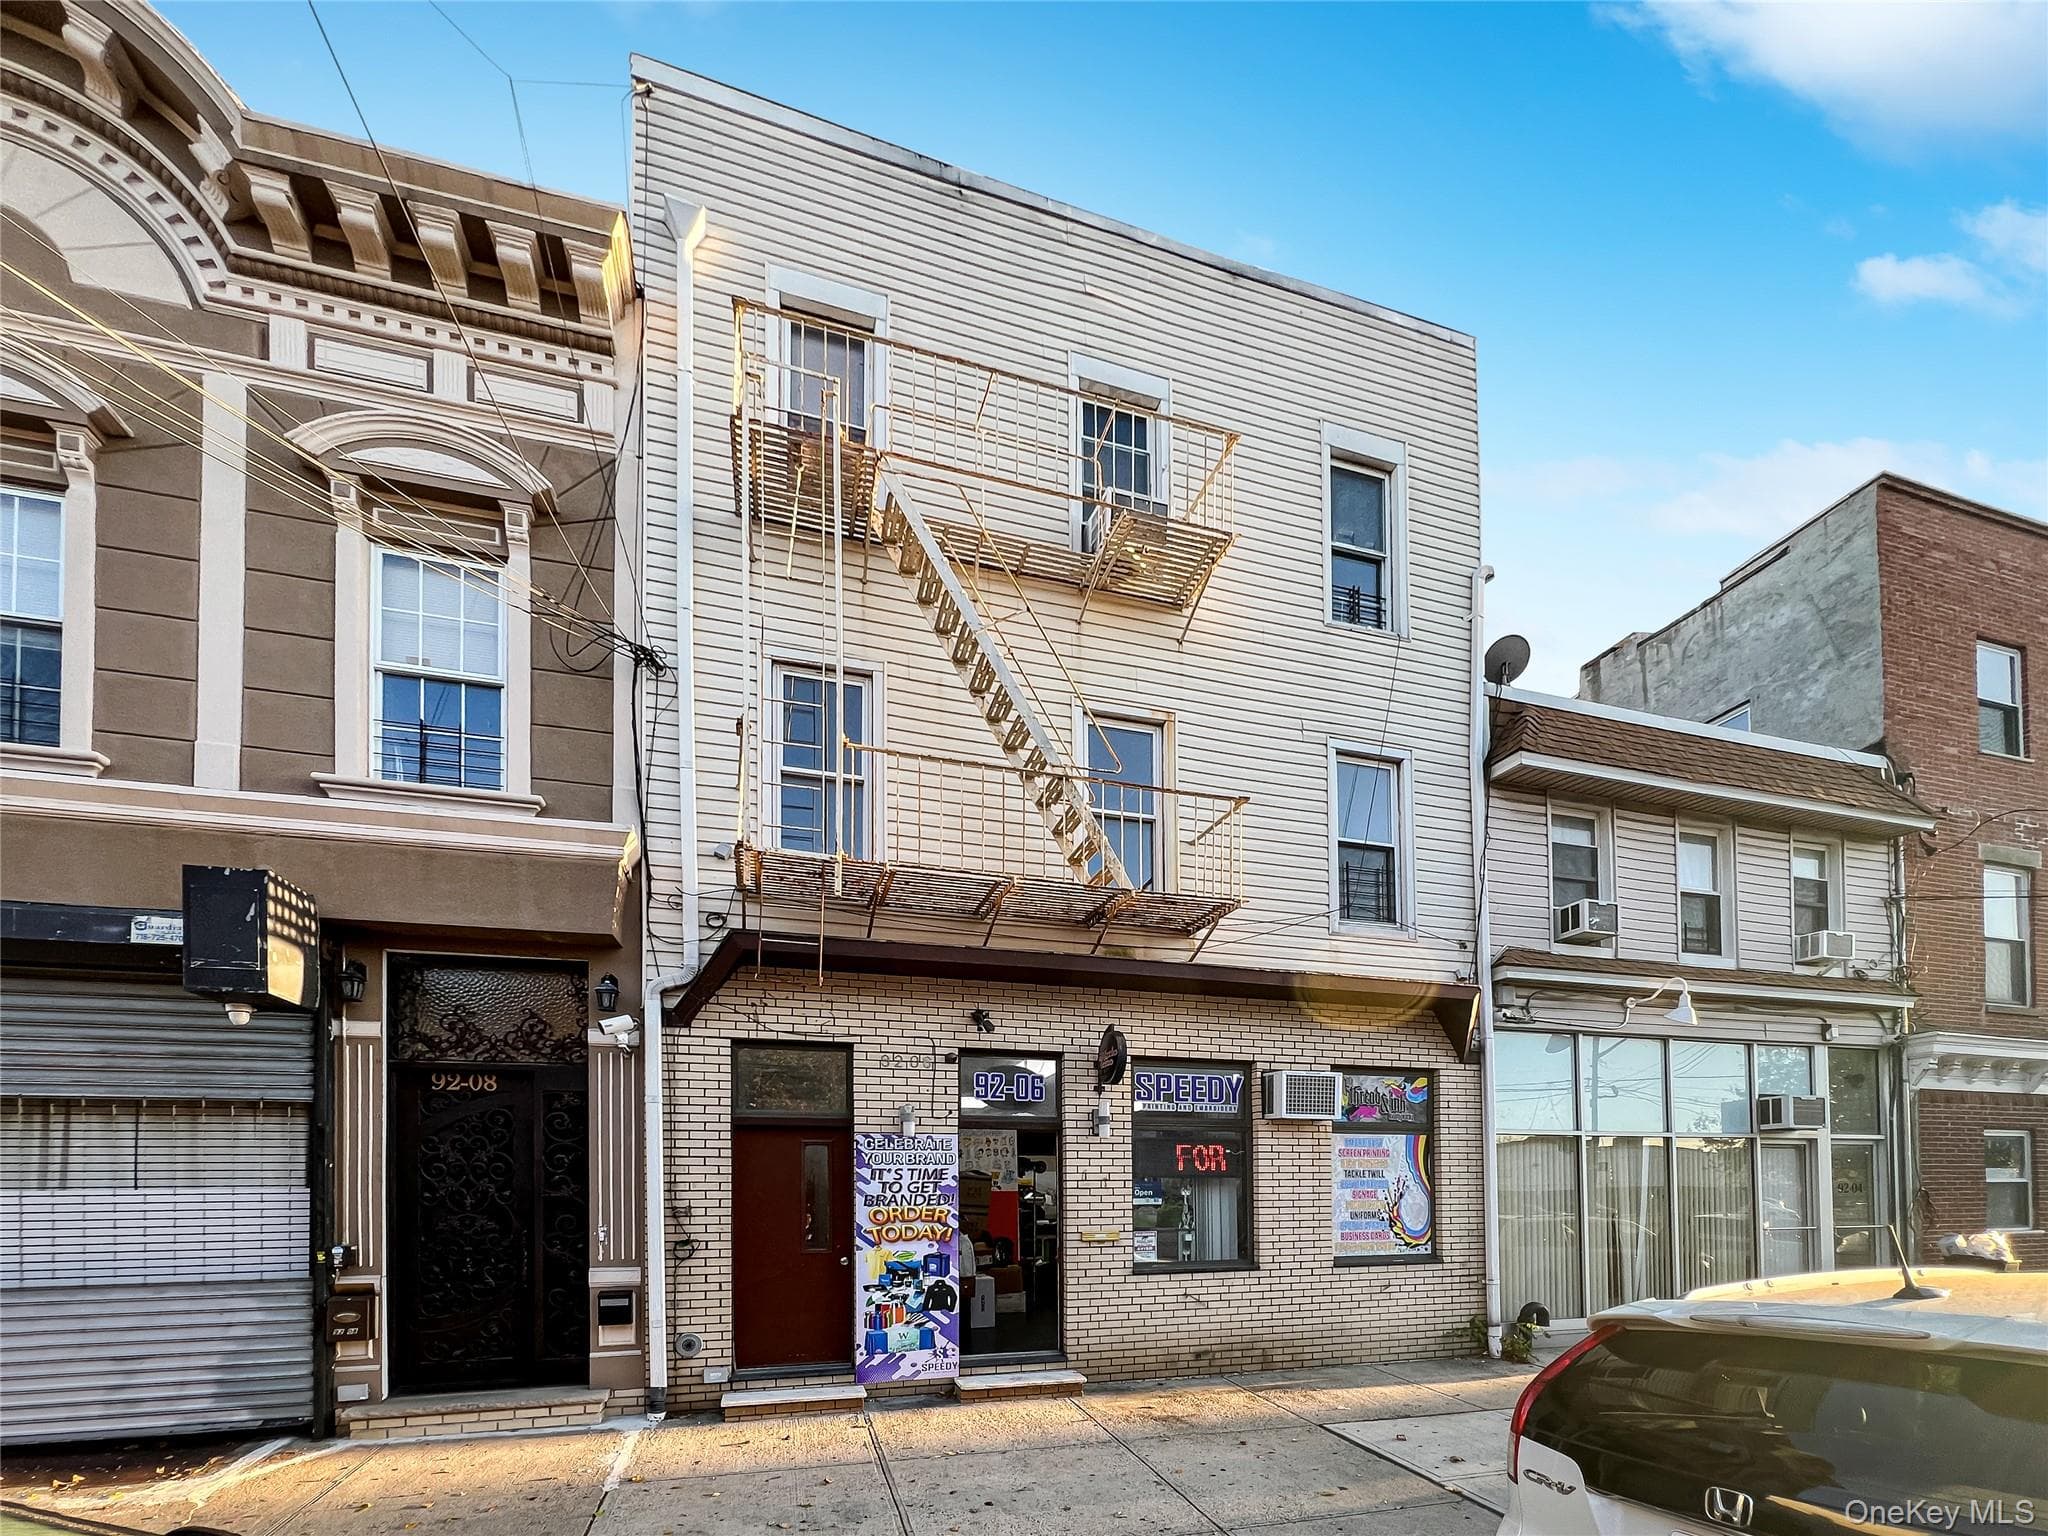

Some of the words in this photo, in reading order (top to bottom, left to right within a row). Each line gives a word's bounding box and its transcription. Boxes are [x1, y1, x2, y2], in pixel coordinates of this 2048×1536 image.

[431, 1072, 497, 1092] 92-08
[974, 1072, 1046, 1102] 92-06
[1135, 1072, 1244, 1104] SPEEDY
[1178, 1103, 1193, 1112] AND
[863, 1137, 953, 1151] CELEBRATE
[862, 1152, 904, 1165] YOUR
[905, 1152, 957, 1166] BRAND
[1176, 1144, 1227, 1171] FOR
[1338, 1148, 1362, 1158] SCREEN
[1363, 1149, 1390, 1158] PRINTING
[870, 1168, 903, 1181] IT'S
[907, 1168, 949, 1181] TIME
[1344, 1169, 1366, 1178] TACKLE
[1366, 1169, 1385, 1178] TWILL
[878, 1181, 903, 1194] TO
[907, 1181, 942, 1194] GET
[1134, 1189, 1153, 1197] Open
[863, 1193, 955, 1207] BRANDED!
[1352, 1190, 1377, 1199] SIGNAGE
[868, 1206, 951, 1225] ORDER
[1350, 1211, 1380, 1220] UNIFORMS
[863, 1224, 954, 1245] TODAY!
[1340, 1231, 1369, 1241] BUSINESS
[1370, 1231, 1390, 1240] CARDS
[921, 1361, 958, 1372] SPEEDY
[1522, 1468, 1577, 1496] CR-V
